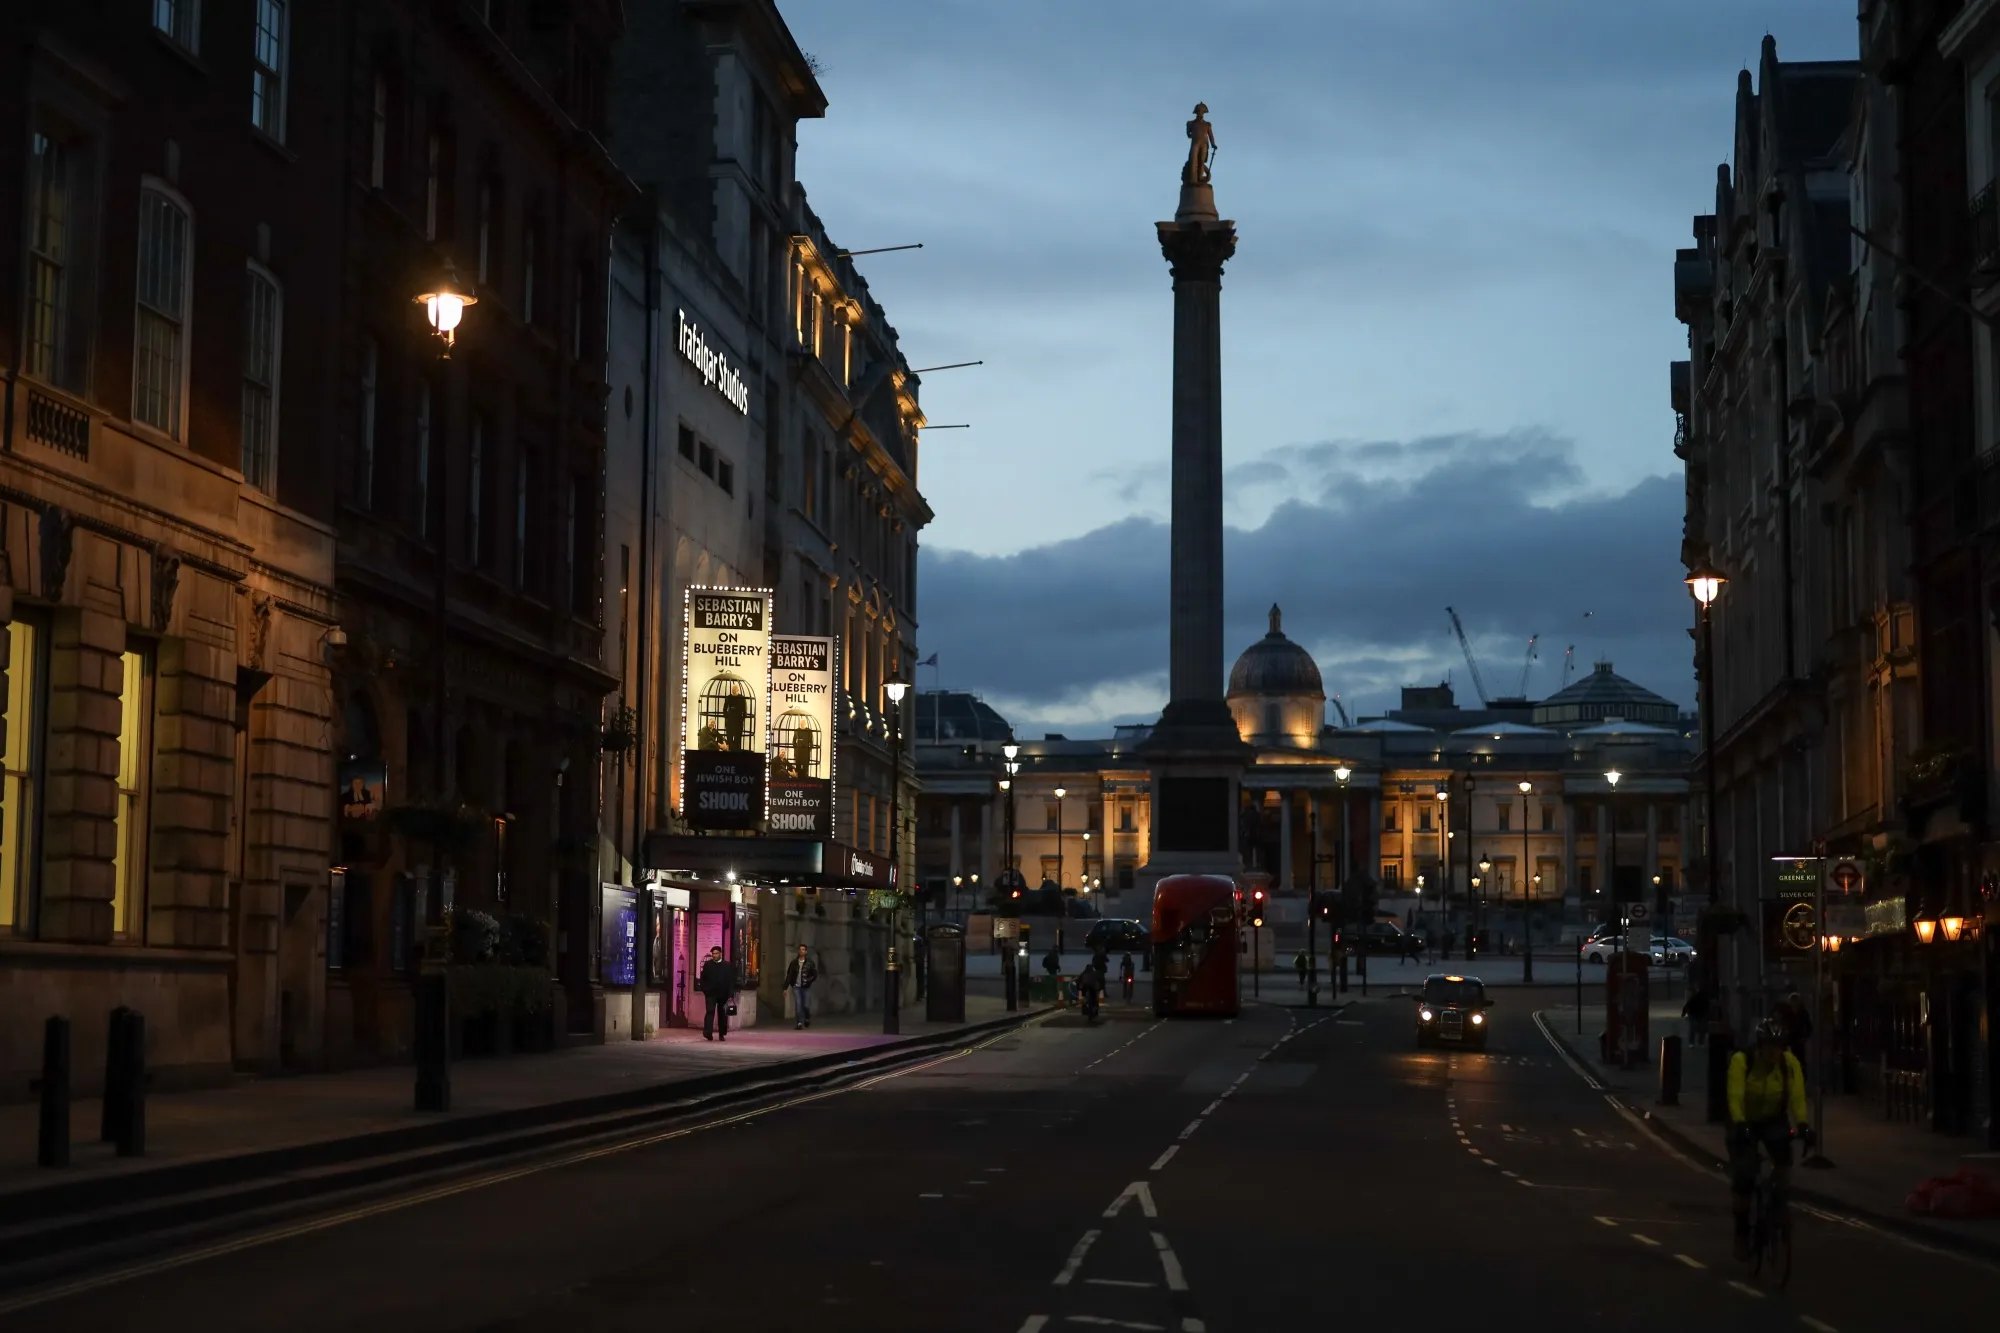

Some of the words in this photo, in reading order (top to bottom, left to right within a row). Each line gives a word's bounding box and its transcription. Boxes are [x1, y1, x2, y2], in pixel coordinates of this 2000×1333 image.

[678, 308, 718, 386] Trafalgar
[718, 351, 748, 416] Studios
[697, 598, 761, 614] SEBASTIAN
[705, 612, 753, 628] BARRY's
[718, 632, 738, 643] ON
[694, 643, 763, 656] BLUEBERRY
[715, 656, 741, 667] HILL
[777, 655, 819, 668] BARRY's
[788, 672, 806, 682] ON
[785, 693, 809, 703] HILL
[714, 765, 736, 774] ONE
[696, 773, 733, 784] JEWISH
[734, 775, 755, 784] BOY
[784, 790, 804, 798] ONE
[699, 791, 749, 811] SHOOK
[802, 799, 821, 807] BOY
[771, 813, 816, 831] SHOOK
